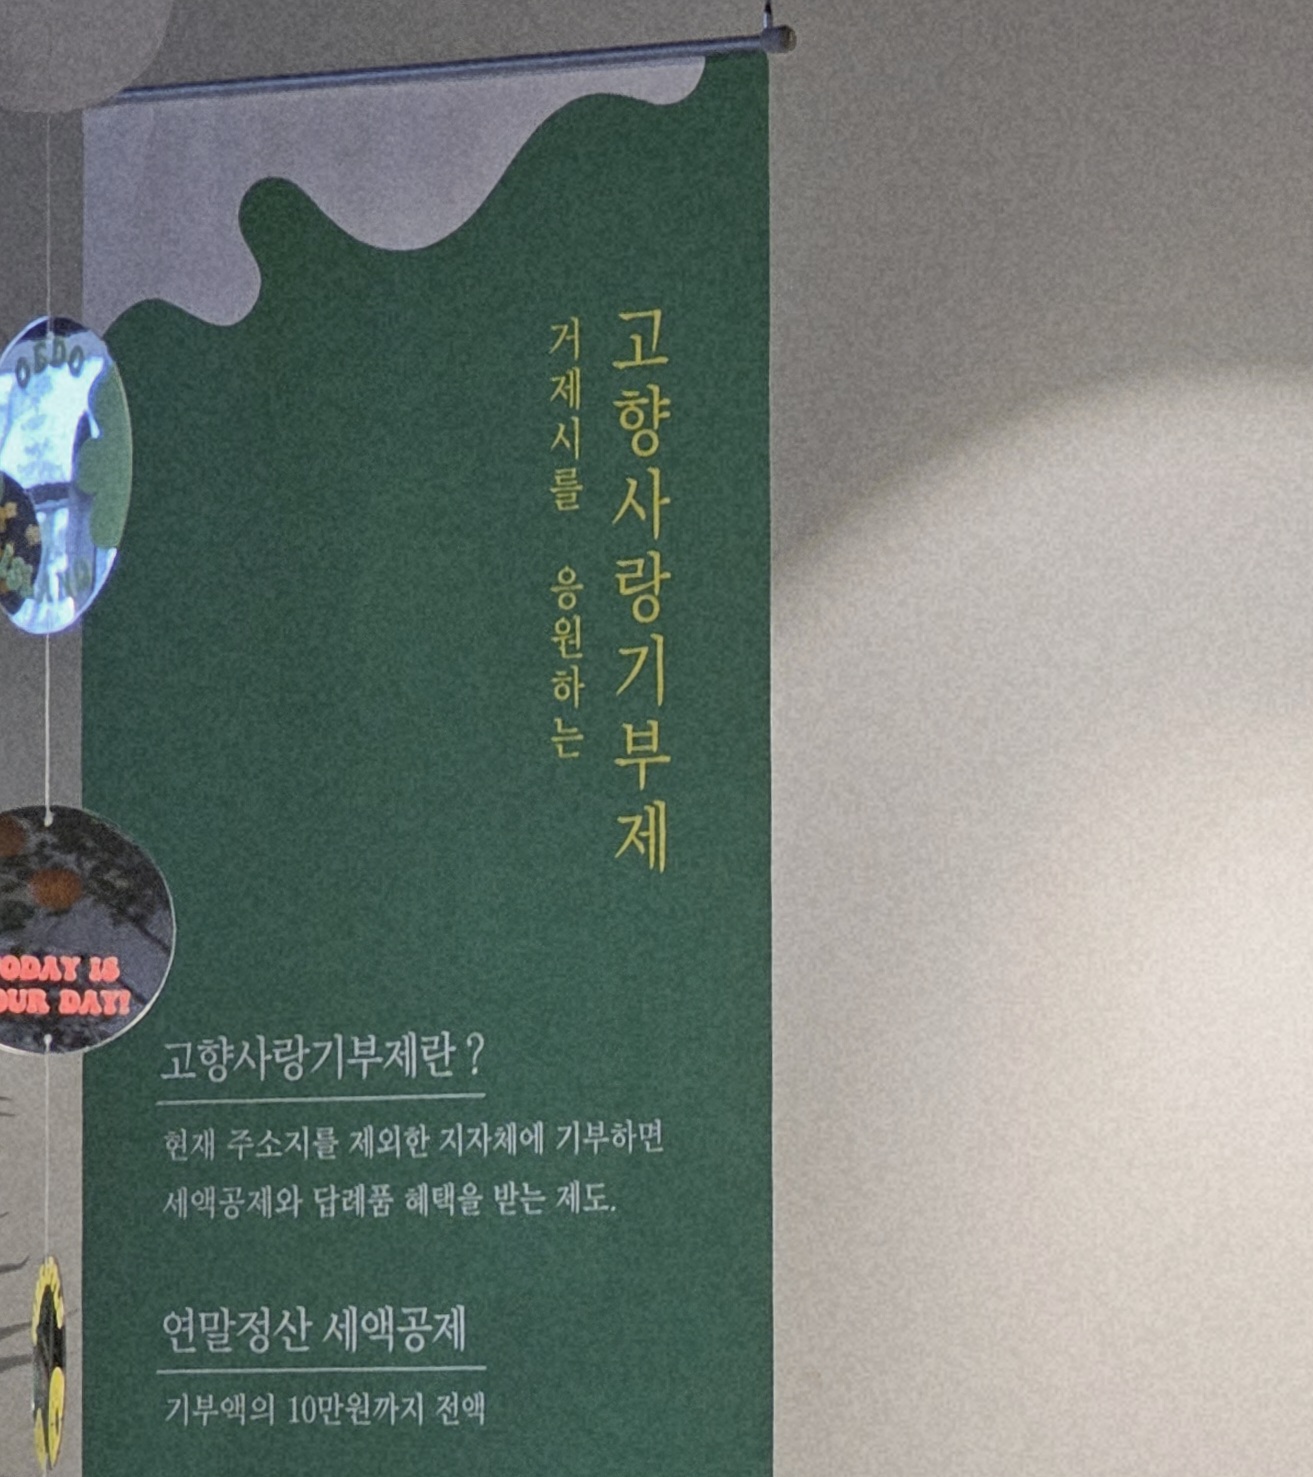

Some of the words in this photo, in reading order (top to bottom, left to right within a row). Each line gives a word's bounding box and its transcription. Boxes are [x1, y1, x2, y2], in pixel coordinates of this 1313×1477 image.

[548, 315, 585, 512] 거제시를
[612, 308, 672, 874] 고향사랑기부제
[549, 564, 586, 760] 응원하는
[88, 956, 121, 982] IS
[58, 989, 132, 1016] DAY!
[160, 1029, 458, 1084] 고향사랑기부제란
[163, 1126, 216, 1163] 현재
[226, 1124, 340, 1161] 주소지를
[349, 1122, 432, 1159] 제외한
[439, 1119, 545, 1158] 지자체에
[556, 1117, 665, 1156] 기부하면
[163, 1183, 305, 1221] 세액공제와
[313, 1182, 395, 1219] 답례품
[404, 1181, 484, 1217] 혜택을
[492, 1179, 547, 1217] 받는
[555, 1178, 617, 1215] 제도.
[162, 1304, 314, 1355] 연말정산
[323, 1303, 467, 1354] 세액공제
[165, 1391, 276, 1428] 기부액의
[289, 1390, 425, 1427] 10만원까지
[436, 1390, 486, 1427] 전액
